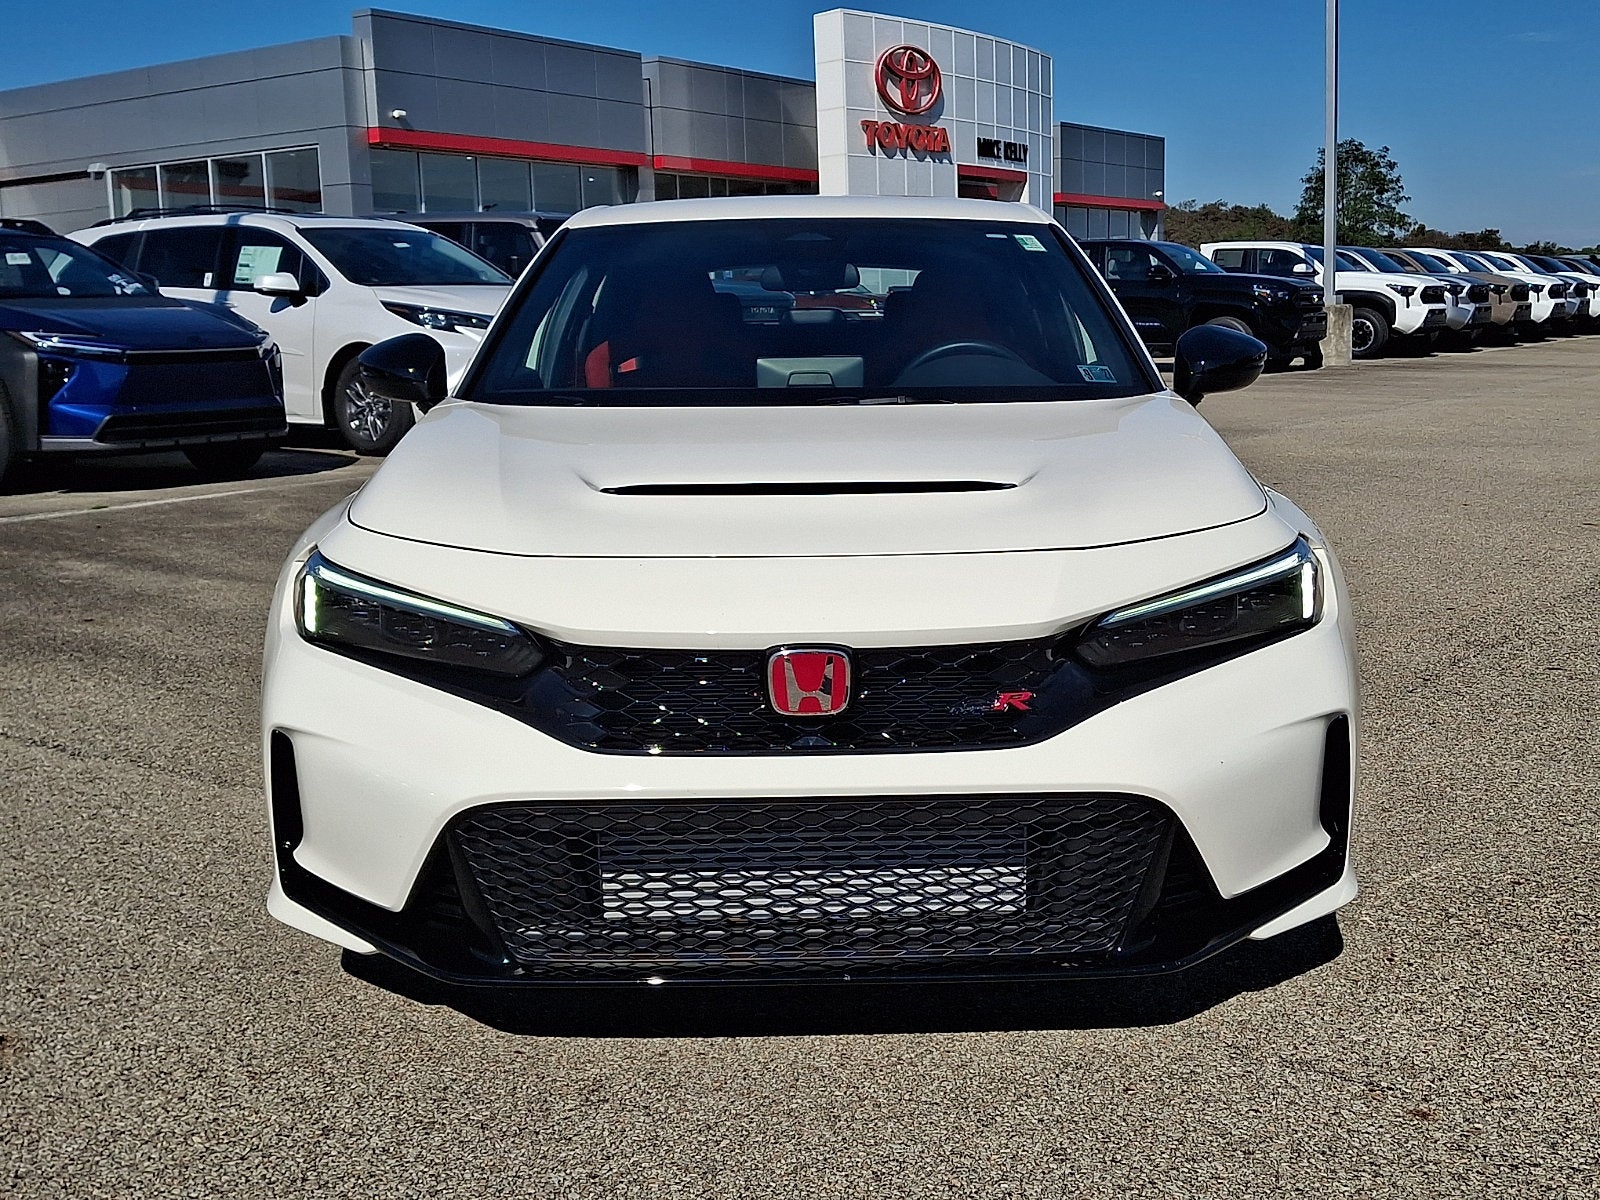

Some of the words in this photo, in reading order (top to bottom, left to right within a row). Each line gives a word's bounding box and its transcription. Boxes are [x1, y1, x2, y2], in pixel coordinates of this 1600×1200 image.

[861, 120, 951, 153] TOYOTA
[977, 137, 1002, 160] MIKE
[1003, 141, 1028, 163] KELLY
